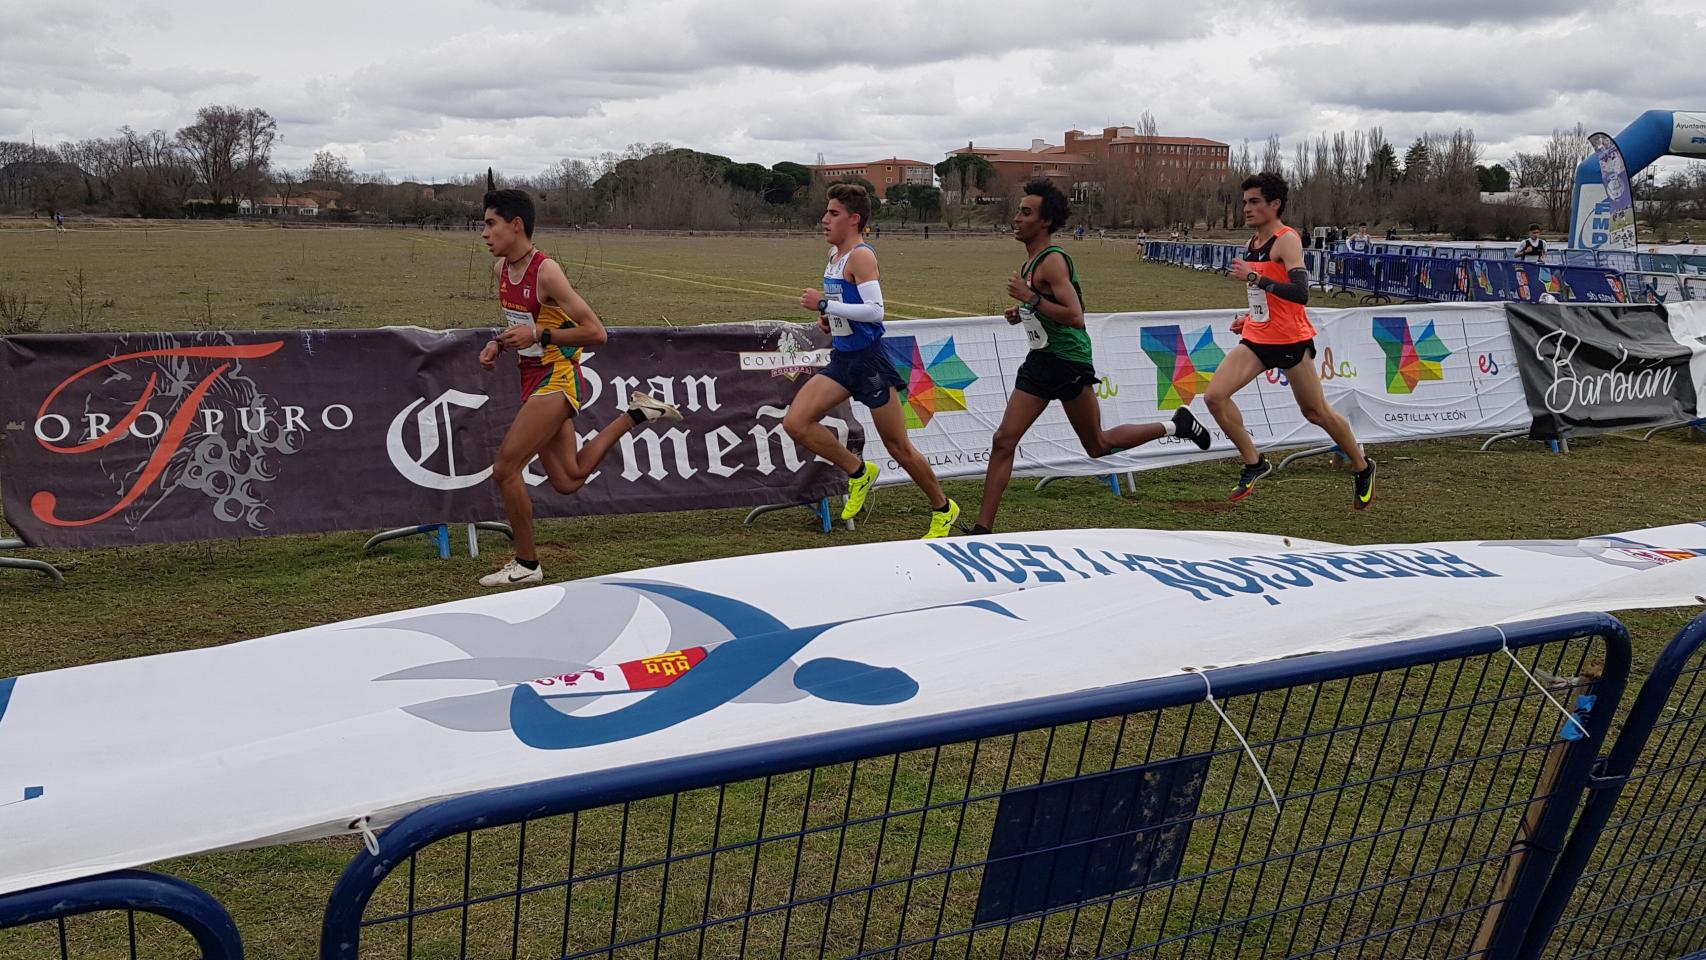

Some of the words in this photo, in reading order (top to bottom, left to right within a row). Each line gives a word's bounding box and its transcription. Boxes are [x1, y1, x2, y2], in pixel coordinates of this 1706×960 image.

[1479, 352, 1499, 376] es
[1536, 328, 1677, 414] Barbián
[34, 411, 164, 442] ORO
[201, 404, 354, 435] PURO
[1384, 413, 1431, 422] CASTILLA
[1432, 412, 1439, 421] Y
[1440, 409, 1467, 421] LEÓN
[955, 453, 963, 464] Y
[967, 448, 991, 462] LEÓ
[1139, 548, 1504, 606] FEDERACIÓN
